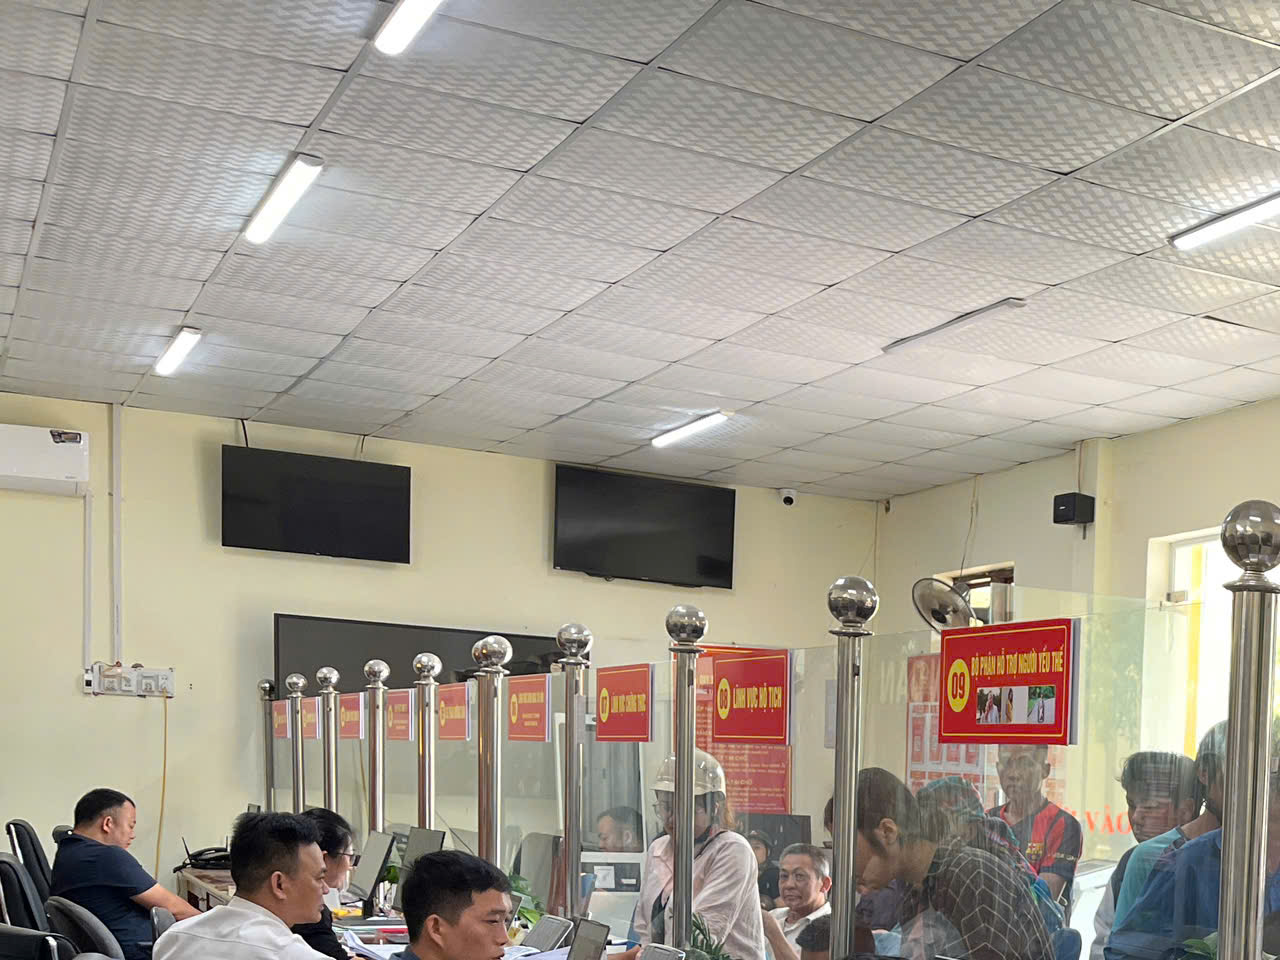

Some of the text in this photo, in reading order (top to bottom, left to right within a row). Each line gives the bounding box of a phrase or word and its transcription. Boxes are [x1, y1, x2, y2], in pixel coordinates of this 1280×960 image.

[980, 651, 996, 680] PHẬN
[1006, 652, 1018, 679] TRỢ
[1051, 644, 1064, 673] THẾ
[768, 686, 782, 712] TỊCH
[951, 672, 966, 700] 09
